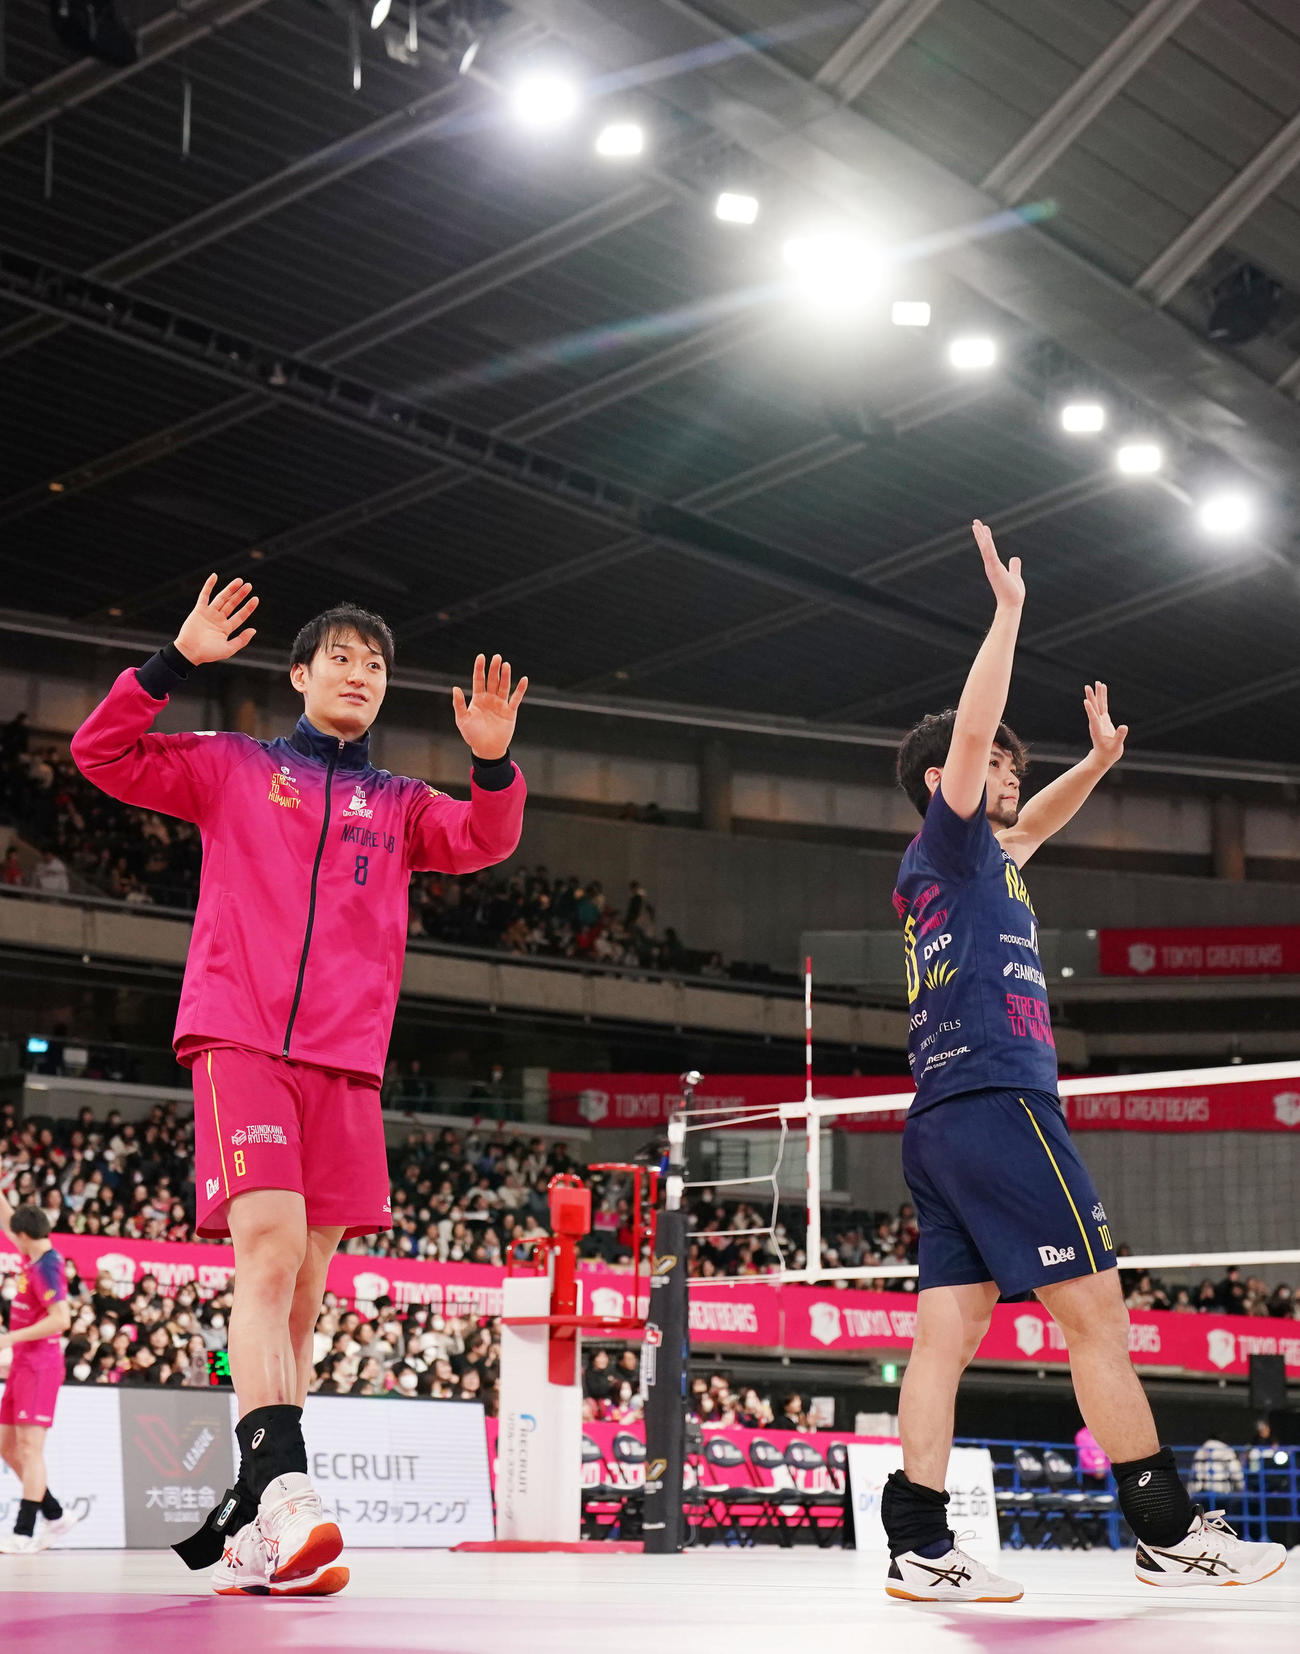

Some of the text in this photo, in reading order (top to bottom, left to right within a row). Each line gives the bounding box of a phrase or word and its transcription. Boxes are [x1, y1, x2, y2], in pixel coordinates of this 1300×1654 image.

[268, 792, 301, 808] HUMANITY
[272, 784, 279, 793] TO
[341, 824, 379, 848] NATURE
[354, 855, 368, 886] 8
[923, 933, 952, 960] DNP
[999, 934, 1031, 949] PRODUCTION
[1161, 944, 1204, 968] TOKYO
[1008, 1016, 1027, 1037] TO
[926, 1045, 971, 1065] MEDICAL
[614, 1093, 660, 1118] TOKYO
[1075, 1095, 1210, 1122] TOKYO GREATBEARS
[246, 1125, 284, 1135] TSUNOKAWA
[248, 1133, 287, 1145] RYUTSU SOKO
[233, 1150, 246, 1177] 8
[1097, 1224, 1113, 1252] 10
[842, 1308, 893, 1338] TOKYO
[313, 1452, 420, 1481] ECRUIT
[145, 1485, 216, 1510] 大同生命
